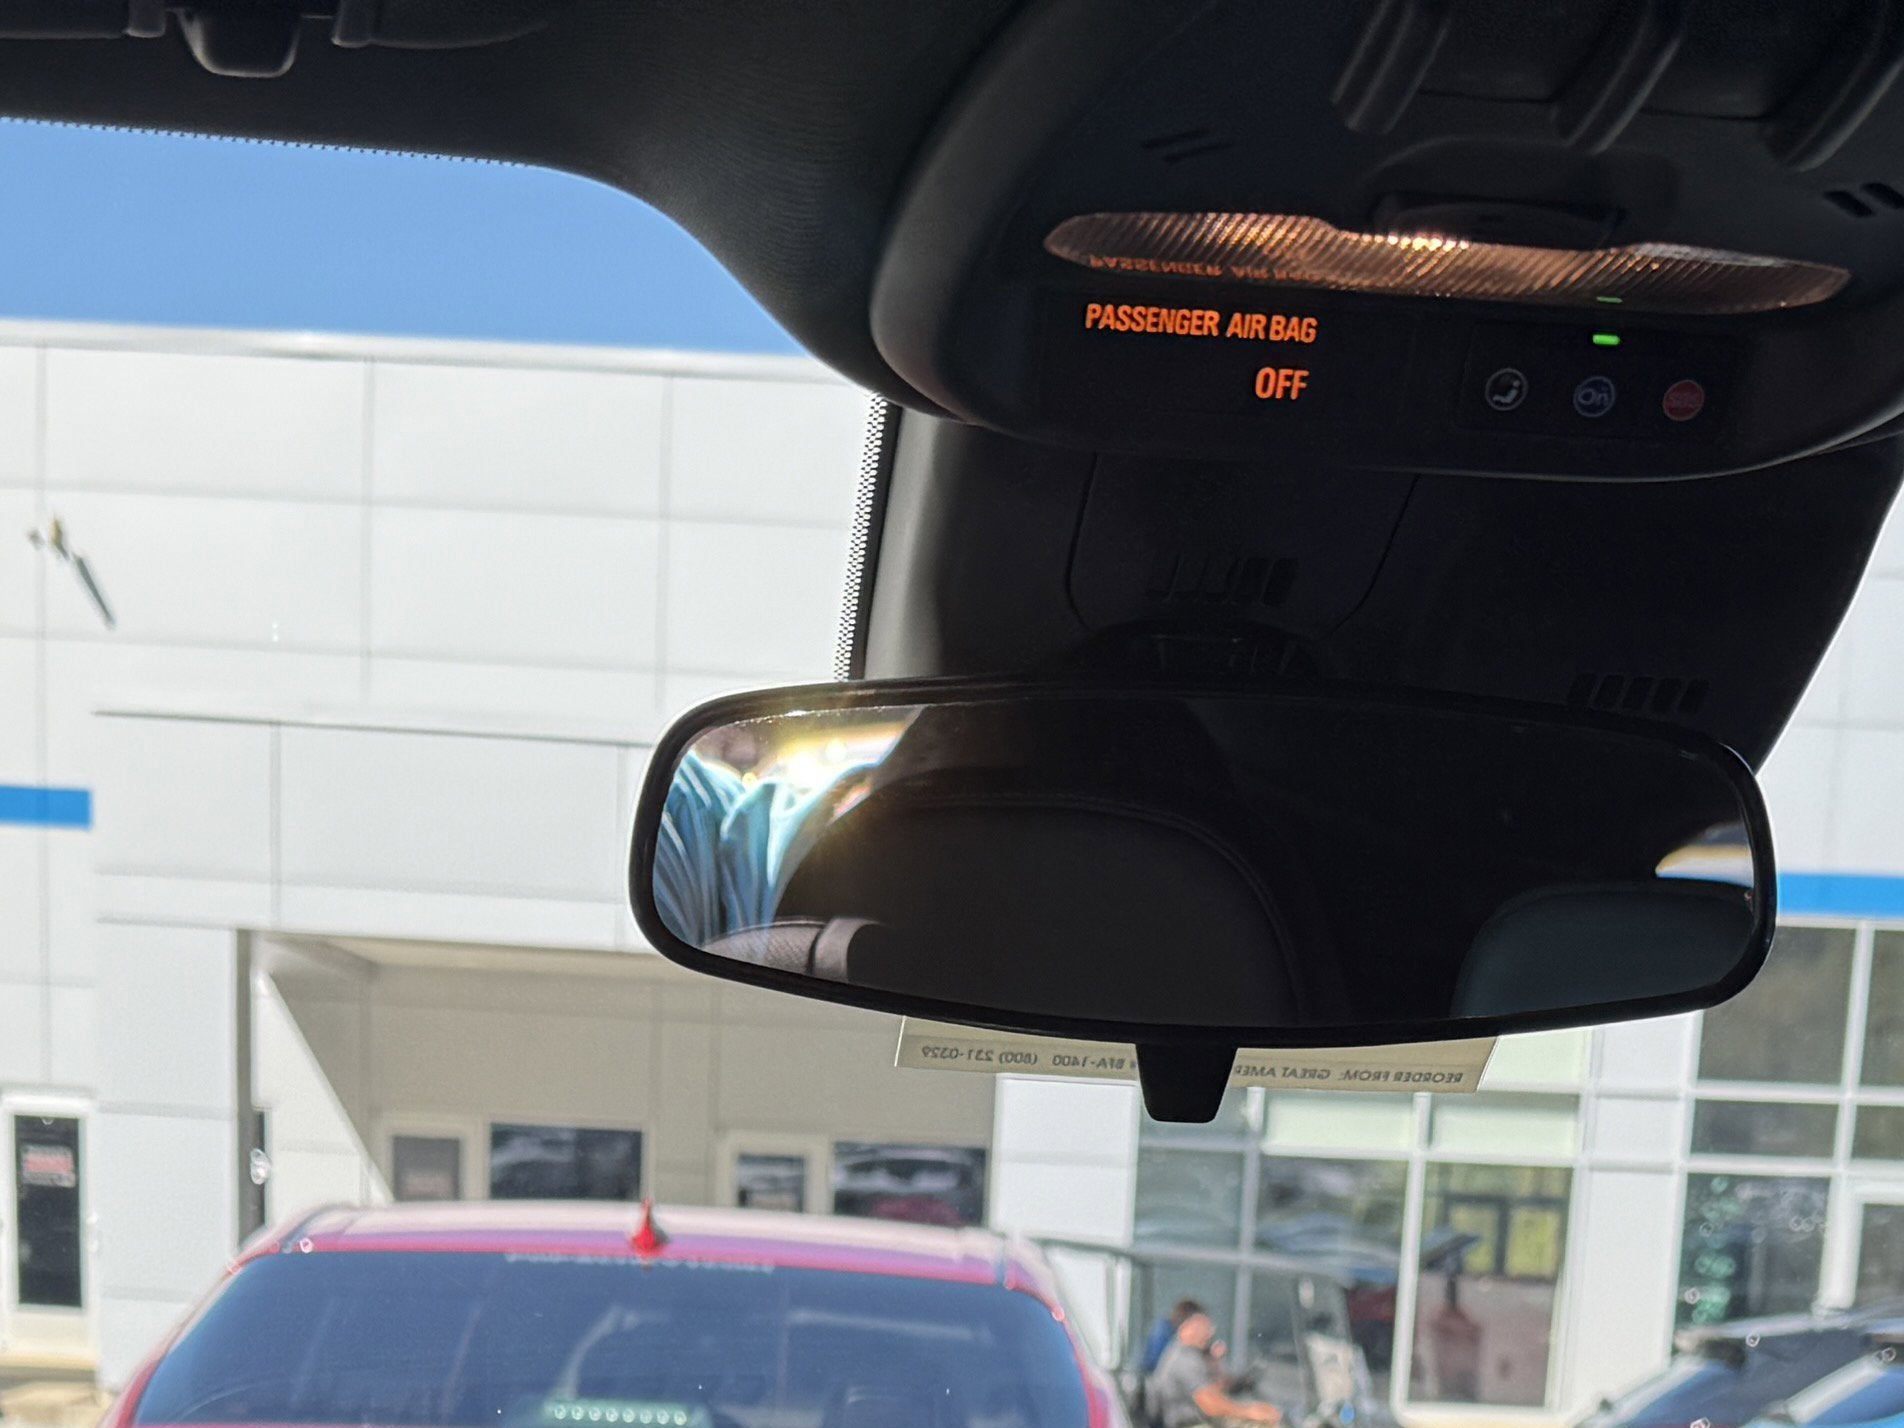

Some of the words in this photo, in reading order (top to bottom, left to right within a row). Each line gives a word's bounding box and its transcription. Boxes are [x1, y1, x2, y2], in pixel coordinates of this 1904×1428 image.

[1085, 303, 1220, 336] PASSENGER
[1225, 312, 1268, 340] AIR
[1268, 315, 1319, 344] BAG
[1254, 366, 1310, 400] OFF
